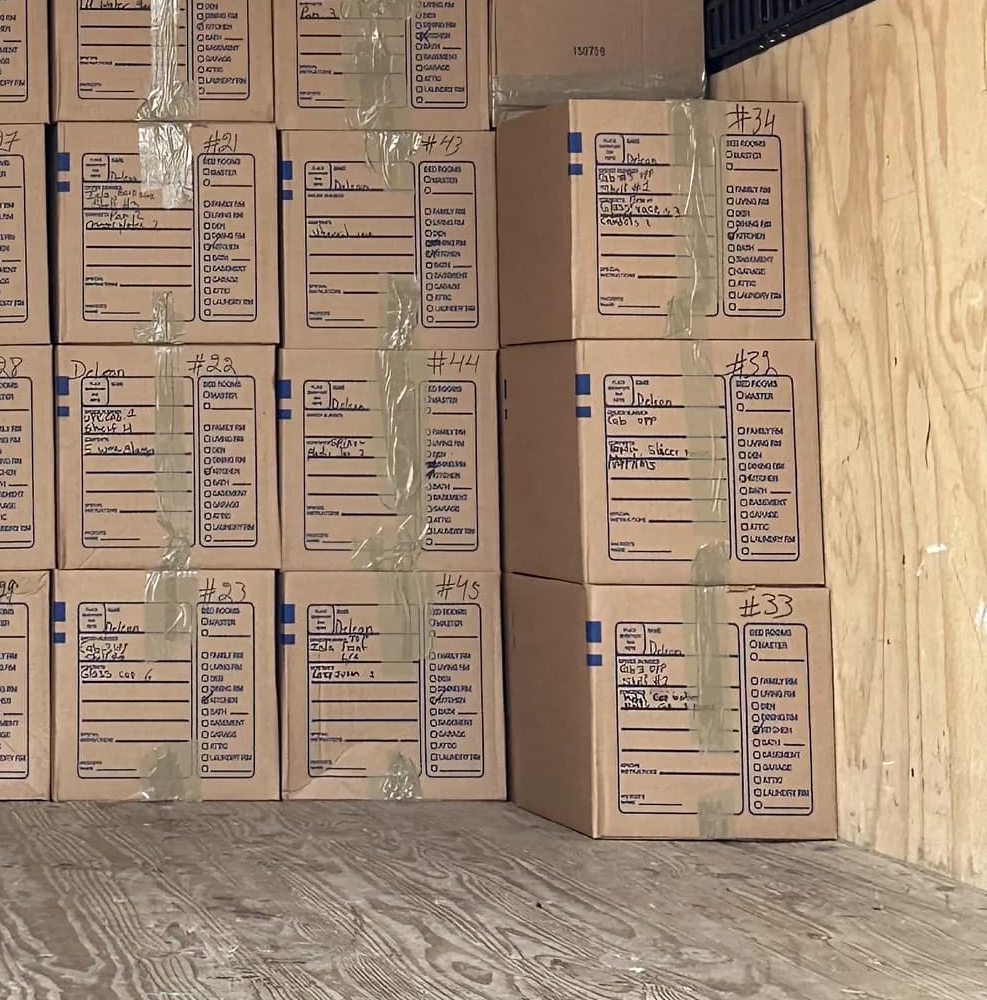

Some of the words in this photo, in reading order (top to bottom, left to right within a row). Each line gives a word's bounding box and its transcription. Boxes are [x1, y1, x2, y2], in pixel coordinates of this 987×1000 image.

[726, 104, 775, 136] #34
[204, 130, 238, 153] #21
[421, 135, 463, 157] #43
[186, 353, 237, 375] #22
[427, 351, 480, 376] #44
[724, 349, 778, 378] #32
[199, 578, 246, 603] #23
[436, 573, 480, 601] #45
[739, 593, 793, 619] #33
